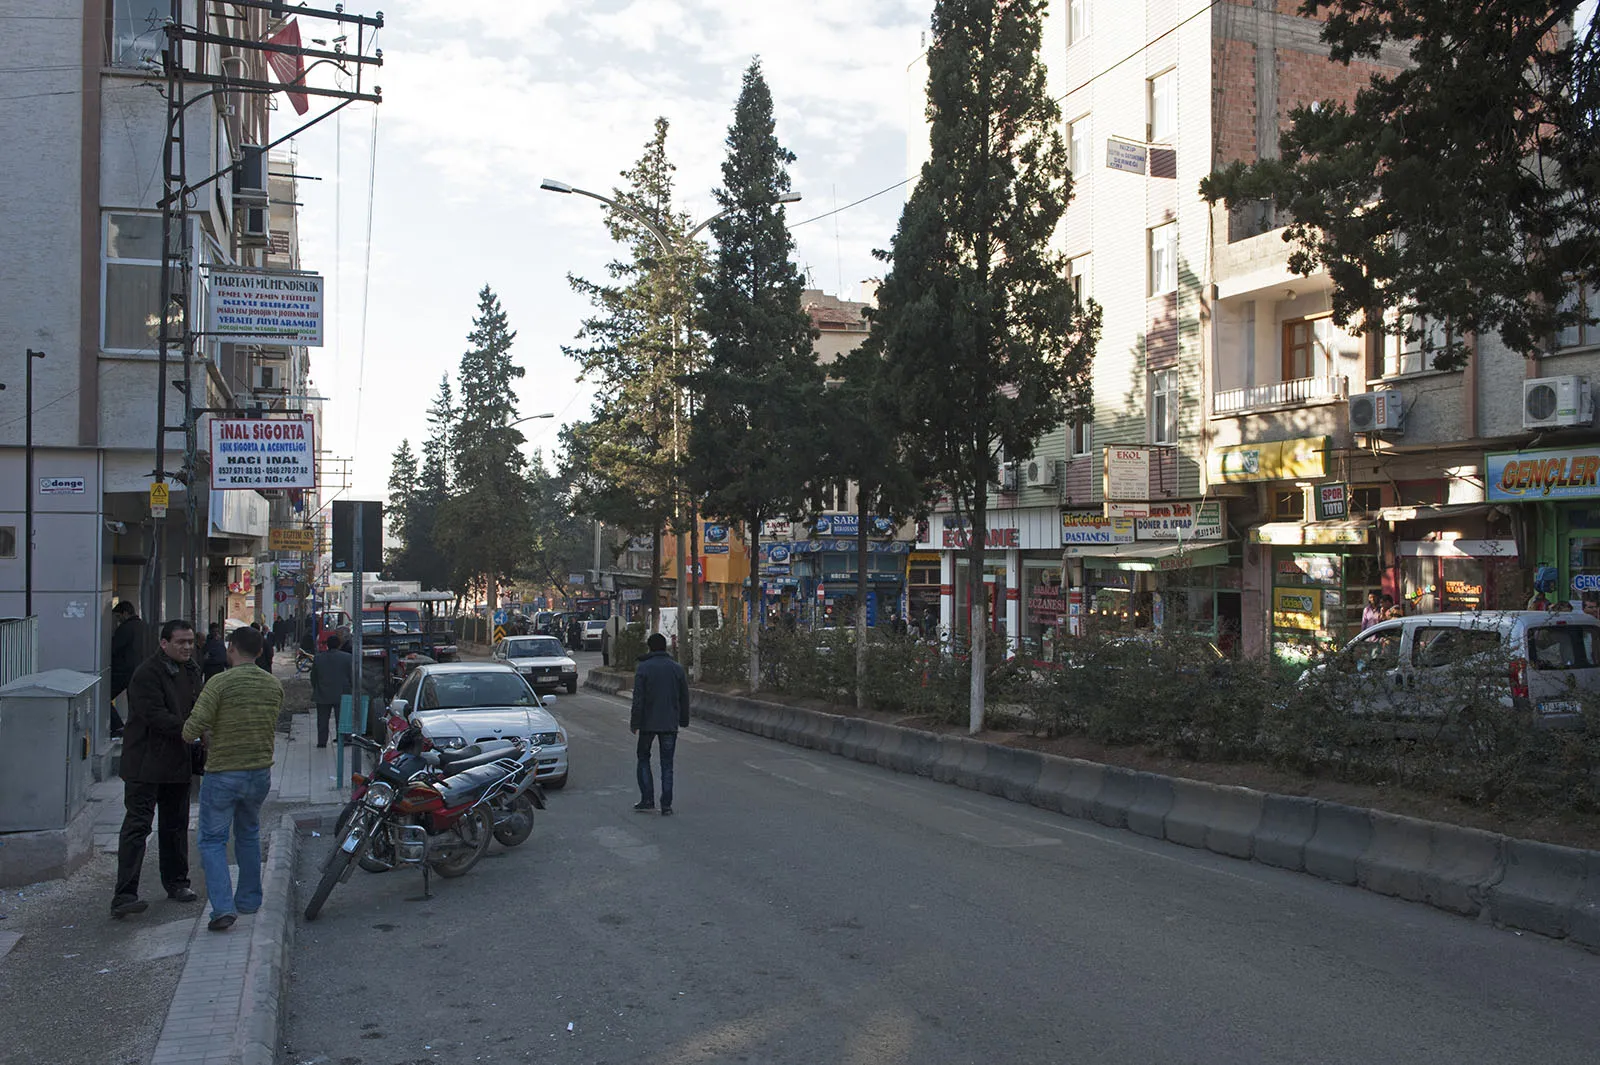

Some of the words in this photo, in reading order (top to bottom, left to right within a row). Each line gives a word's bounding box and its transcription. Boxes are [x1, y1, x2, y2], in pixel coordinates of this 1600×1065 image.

[260, 443, 265, 452] A
[1117, 451, 1141, 459] EKOL
[1502, 455, 1599, 496] GENÇLER
[52, 480, 83, 488] donge
[1322, 487, 1342, 501] SPOR
[1324, 502, 1343, 515] TOTO
[1138, 518, 1161, 529] DÖNER
[1163, 520, 1170, 529] &
